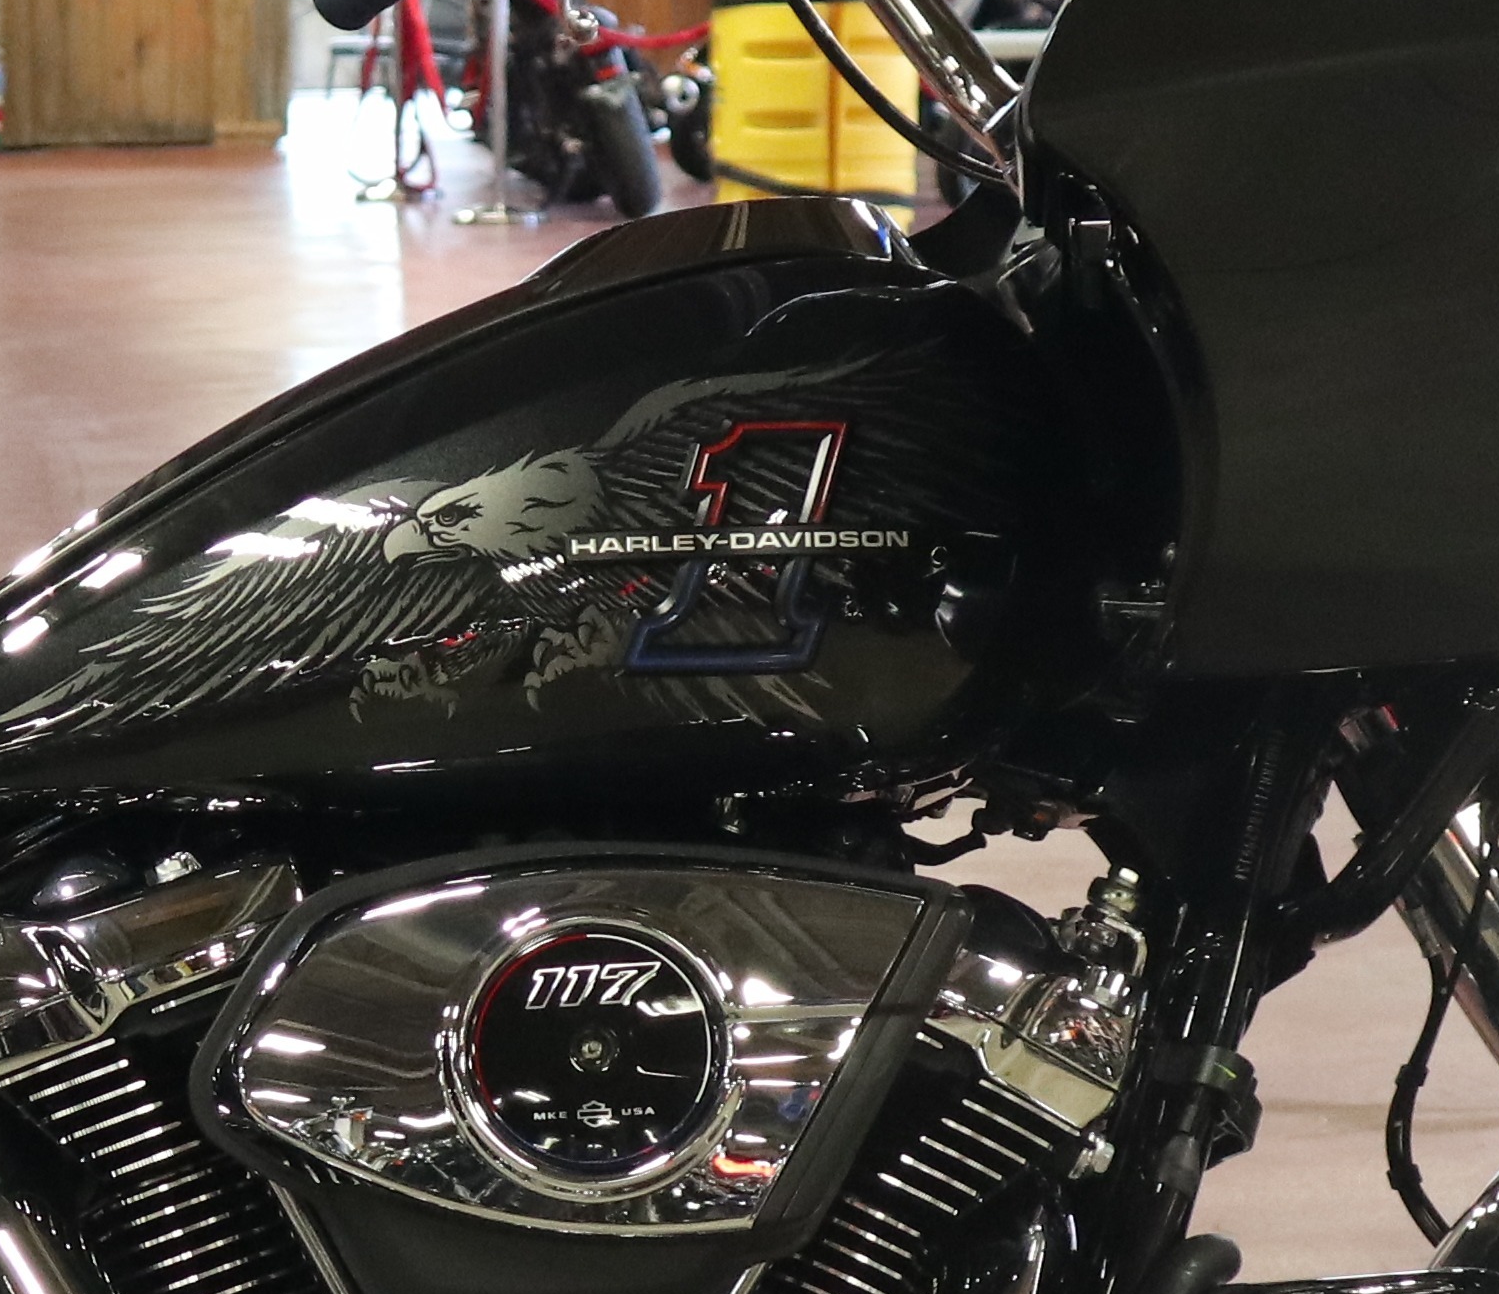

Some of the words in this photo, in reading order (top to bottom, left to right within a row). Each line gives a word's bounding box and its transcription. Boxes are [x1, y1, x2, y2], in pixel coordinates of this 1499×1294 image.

[570, 529, 910, 556] HARLEY-DAVIDSON
[525, 960, 662, 1010] 117
[533, 1110, 569, 1121] MKE
[621, 1106, 656, 1117] USA
